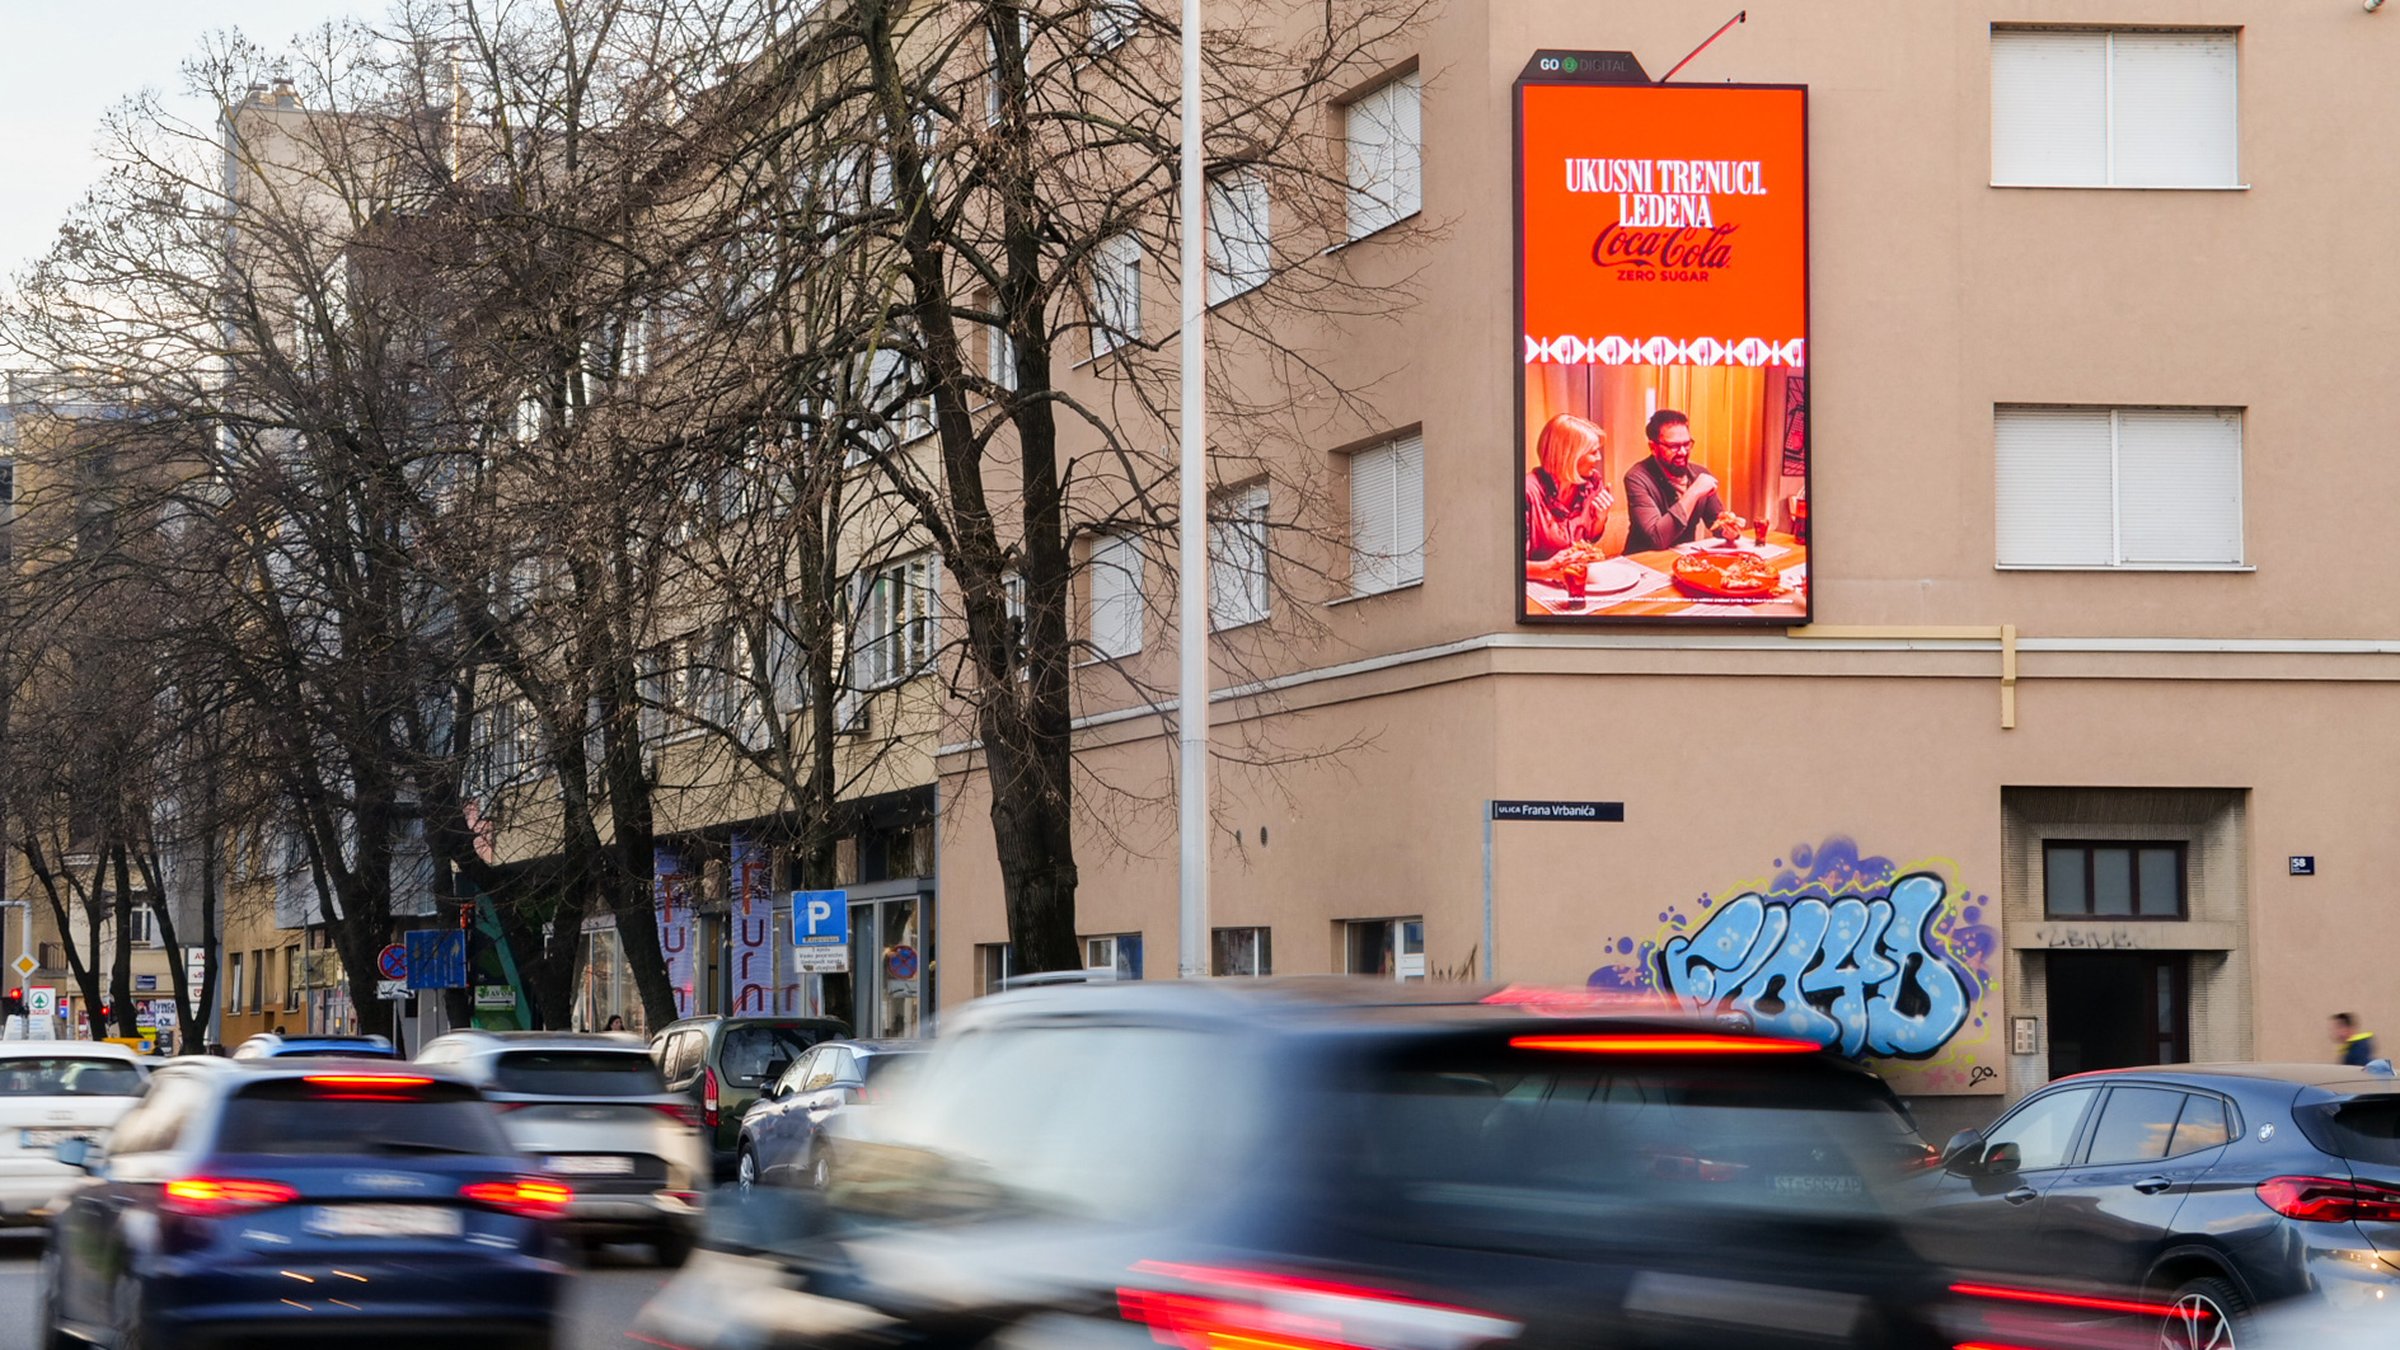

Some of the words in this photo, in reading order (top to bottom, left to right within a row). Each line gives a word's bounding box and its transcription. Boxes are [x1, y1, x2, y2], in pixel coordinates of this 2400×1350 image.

[1540, 58, 1559, 71] GO
[1580, 59, 1628, 72] DIGITAL
[1565, 158, 1652, 192] UKUSNI
[1656, 160, 1767, 194] TRENUCI.
[1618, 194, 1713, 228] LEDENA
[1592, 221, 1739, 268] Coca-Cola
[1617, 270, 1655, 281] ZERO
[1660, 270, 1709, 282] SUGAR
[1498, 806, 1521, 814] ULICA
[1522, 805, 1551, 816] Frana
[1552, 805, 1596, 817] Vrbanića
[808, 901, 831, 935] P
